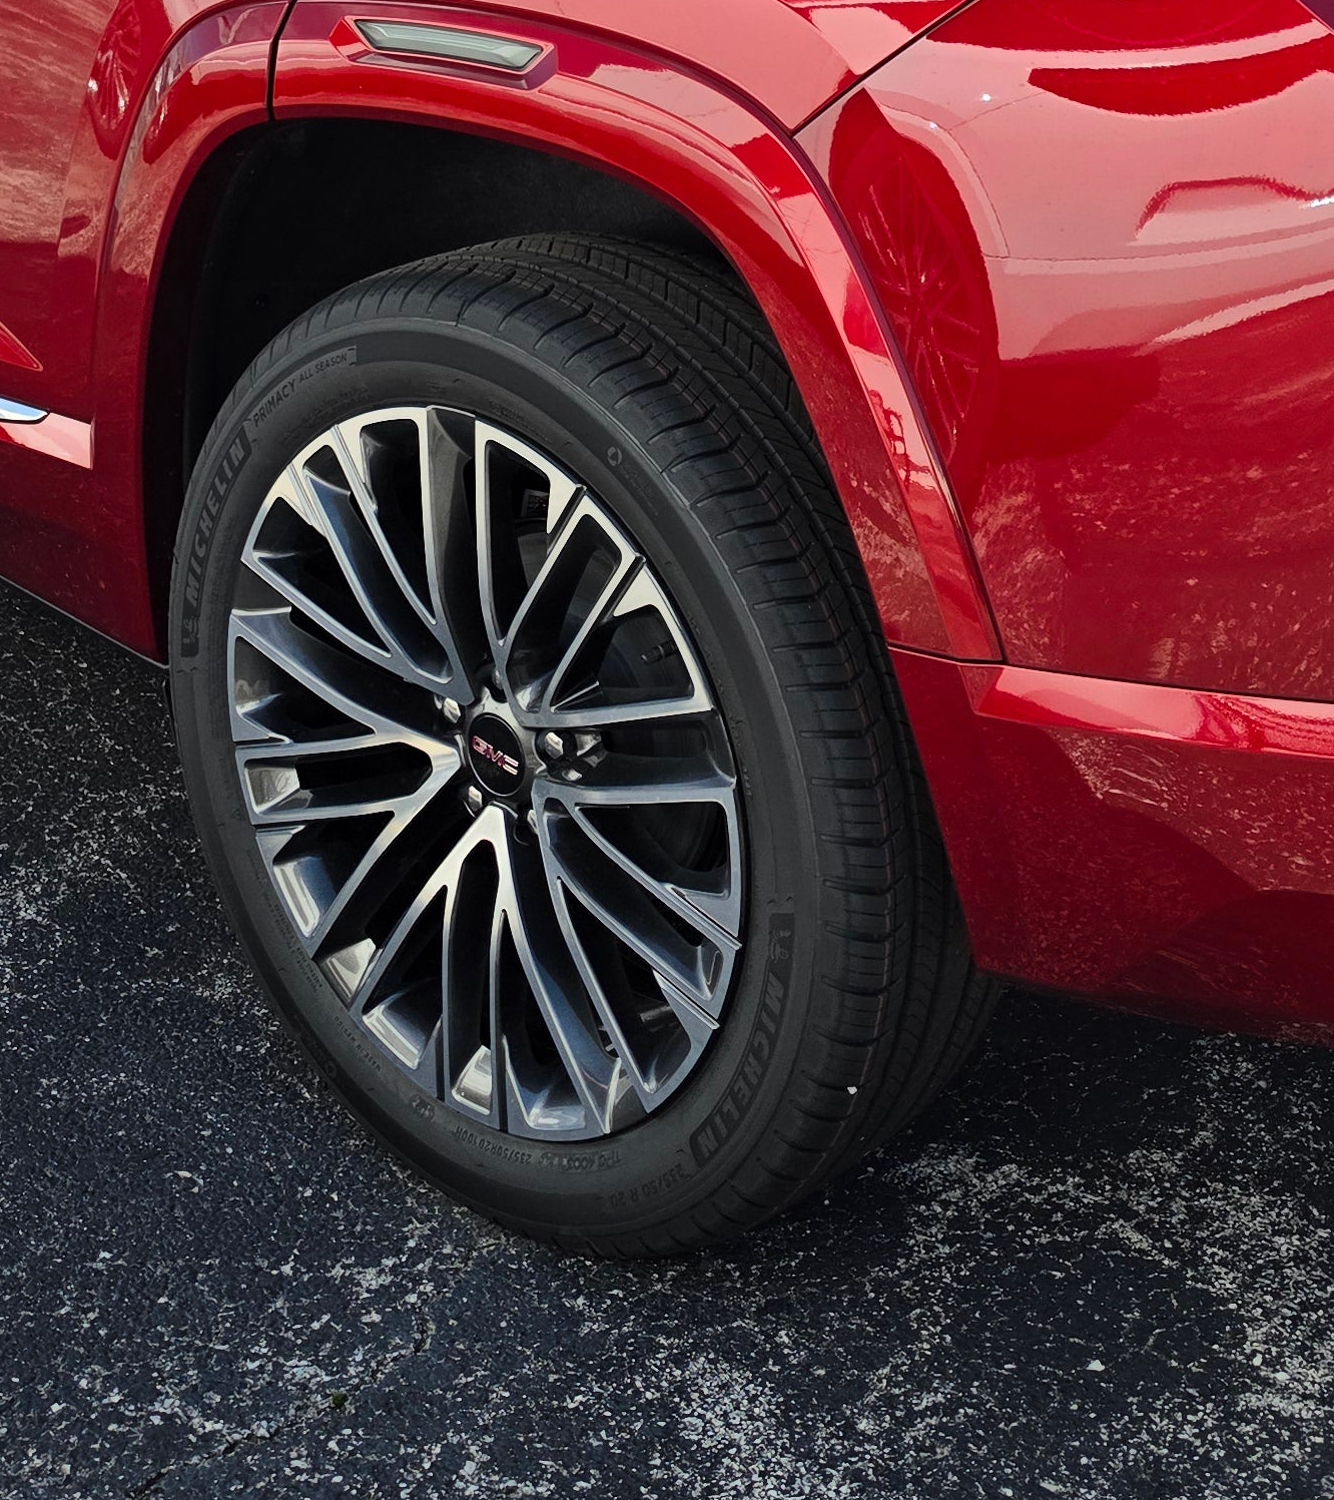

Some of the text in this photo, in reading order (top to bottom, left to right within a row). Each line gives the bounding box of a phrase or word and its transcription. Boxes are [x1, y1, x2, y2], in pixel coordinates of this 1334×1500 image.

[185, 351, 348, 607] MICHELIN PRIMACY ALL SEASON
[472, 735, 520, 776] GMC
[697, 972, 785, 1159] MICHELIN
[642, 1162, 687, 1197] 235/50
